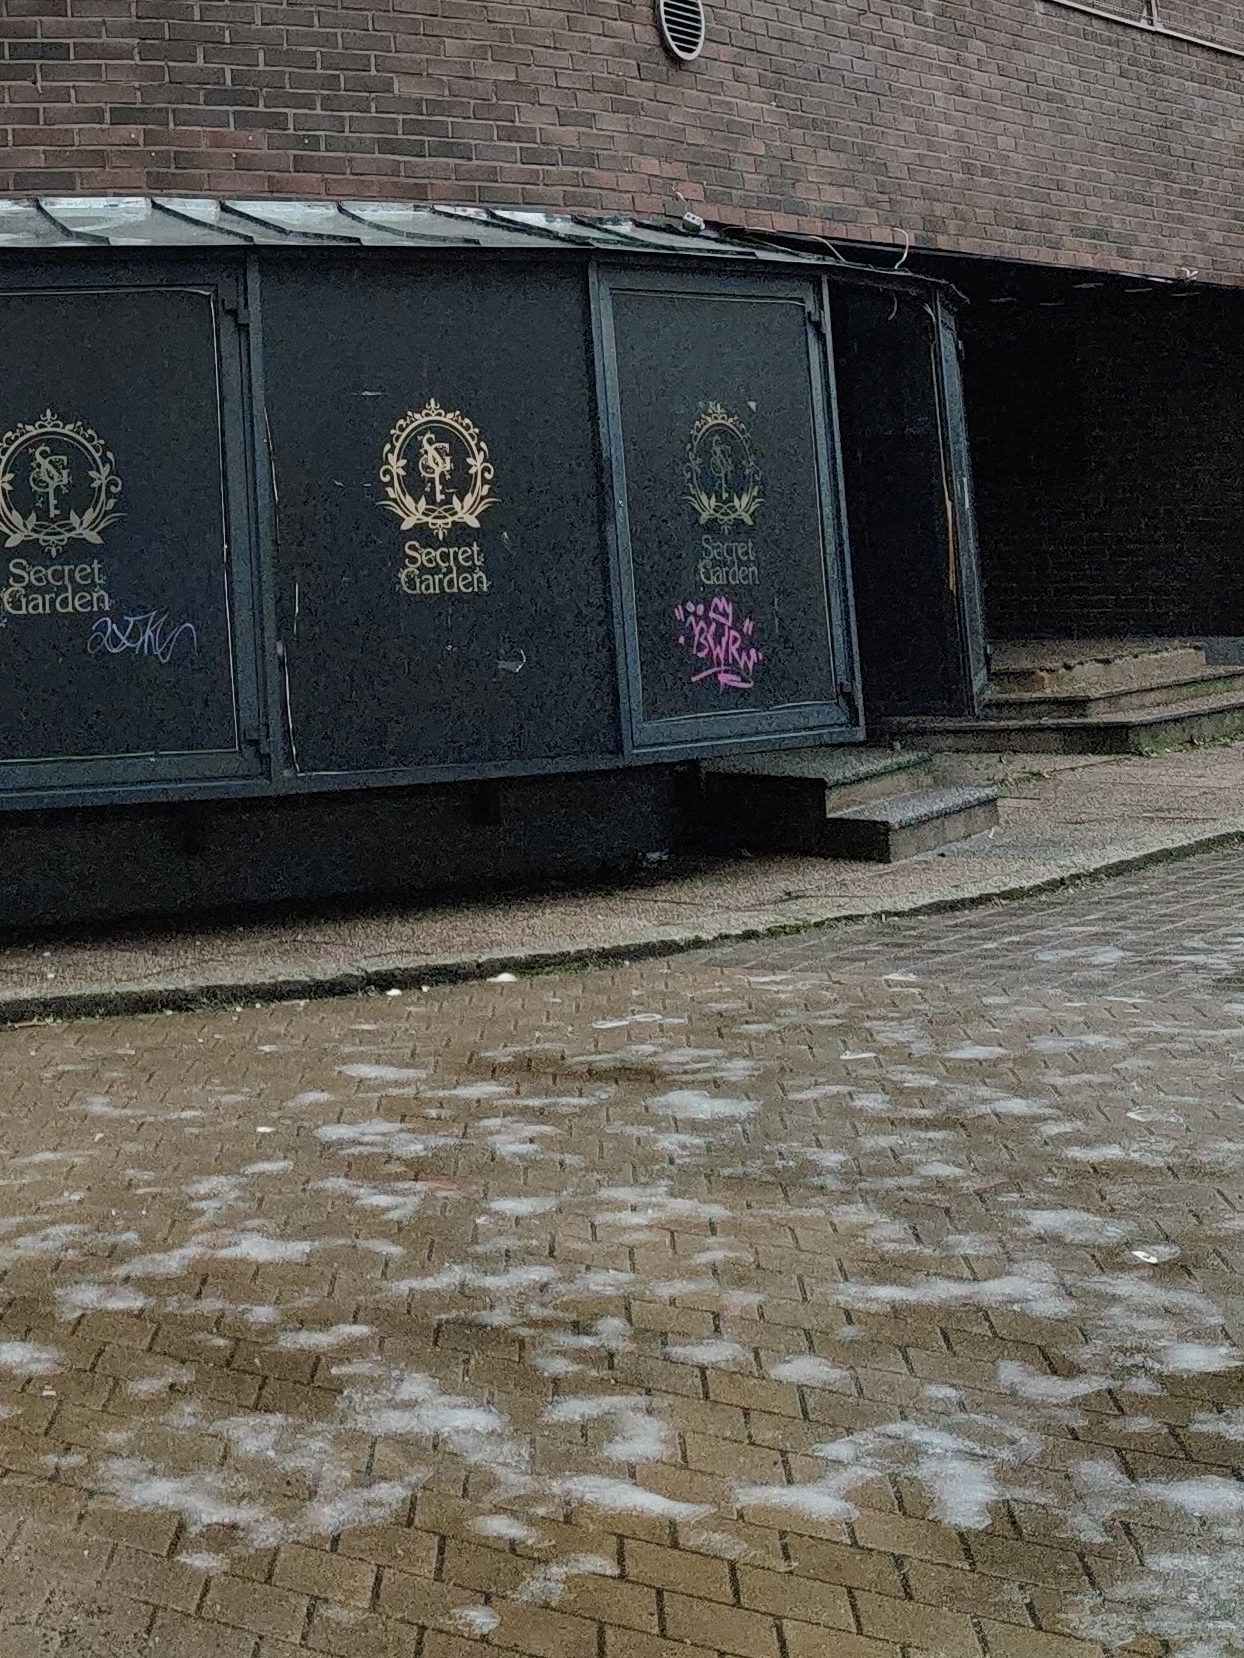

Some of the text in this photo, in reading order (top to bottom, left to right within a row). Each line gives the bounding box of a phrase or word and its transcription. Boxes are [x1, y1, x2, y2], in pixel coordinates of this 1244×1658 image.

[405, 541, 484, 568] Secret
[702, 534, 756, 561] Secret
[8, 558, 106, 587] Secret
[399, 566, 489, 594] Garden
[698, 559, 760, 585] Garden
[2, 583, 111, 615] Garden
